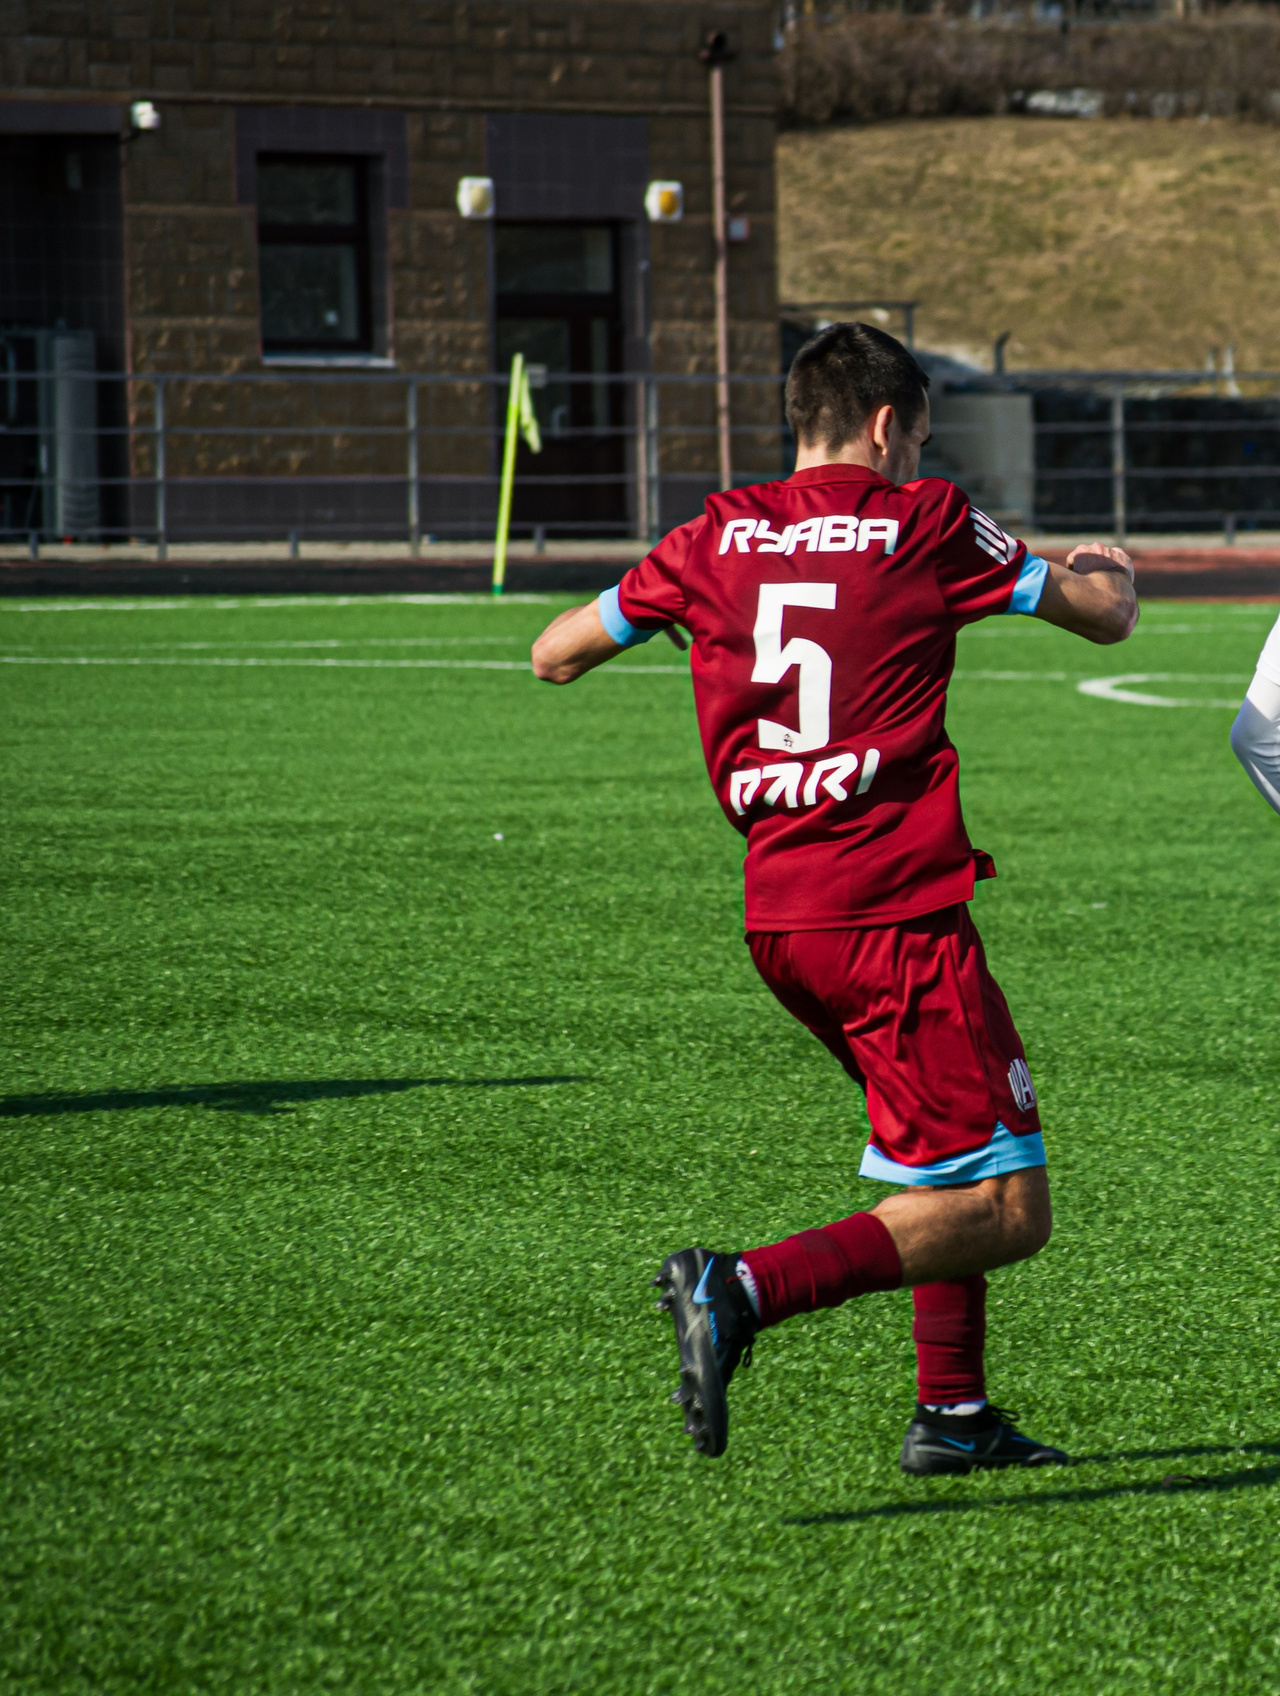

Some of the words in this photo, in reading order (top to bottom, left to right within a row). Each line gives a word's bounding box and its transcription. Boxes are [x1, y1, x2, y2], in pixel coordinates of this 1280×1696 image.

[719, 515, 899, 555] RYABA
[751, 583, 837, 753] 5
[730, 748, 881, 816] PARI
